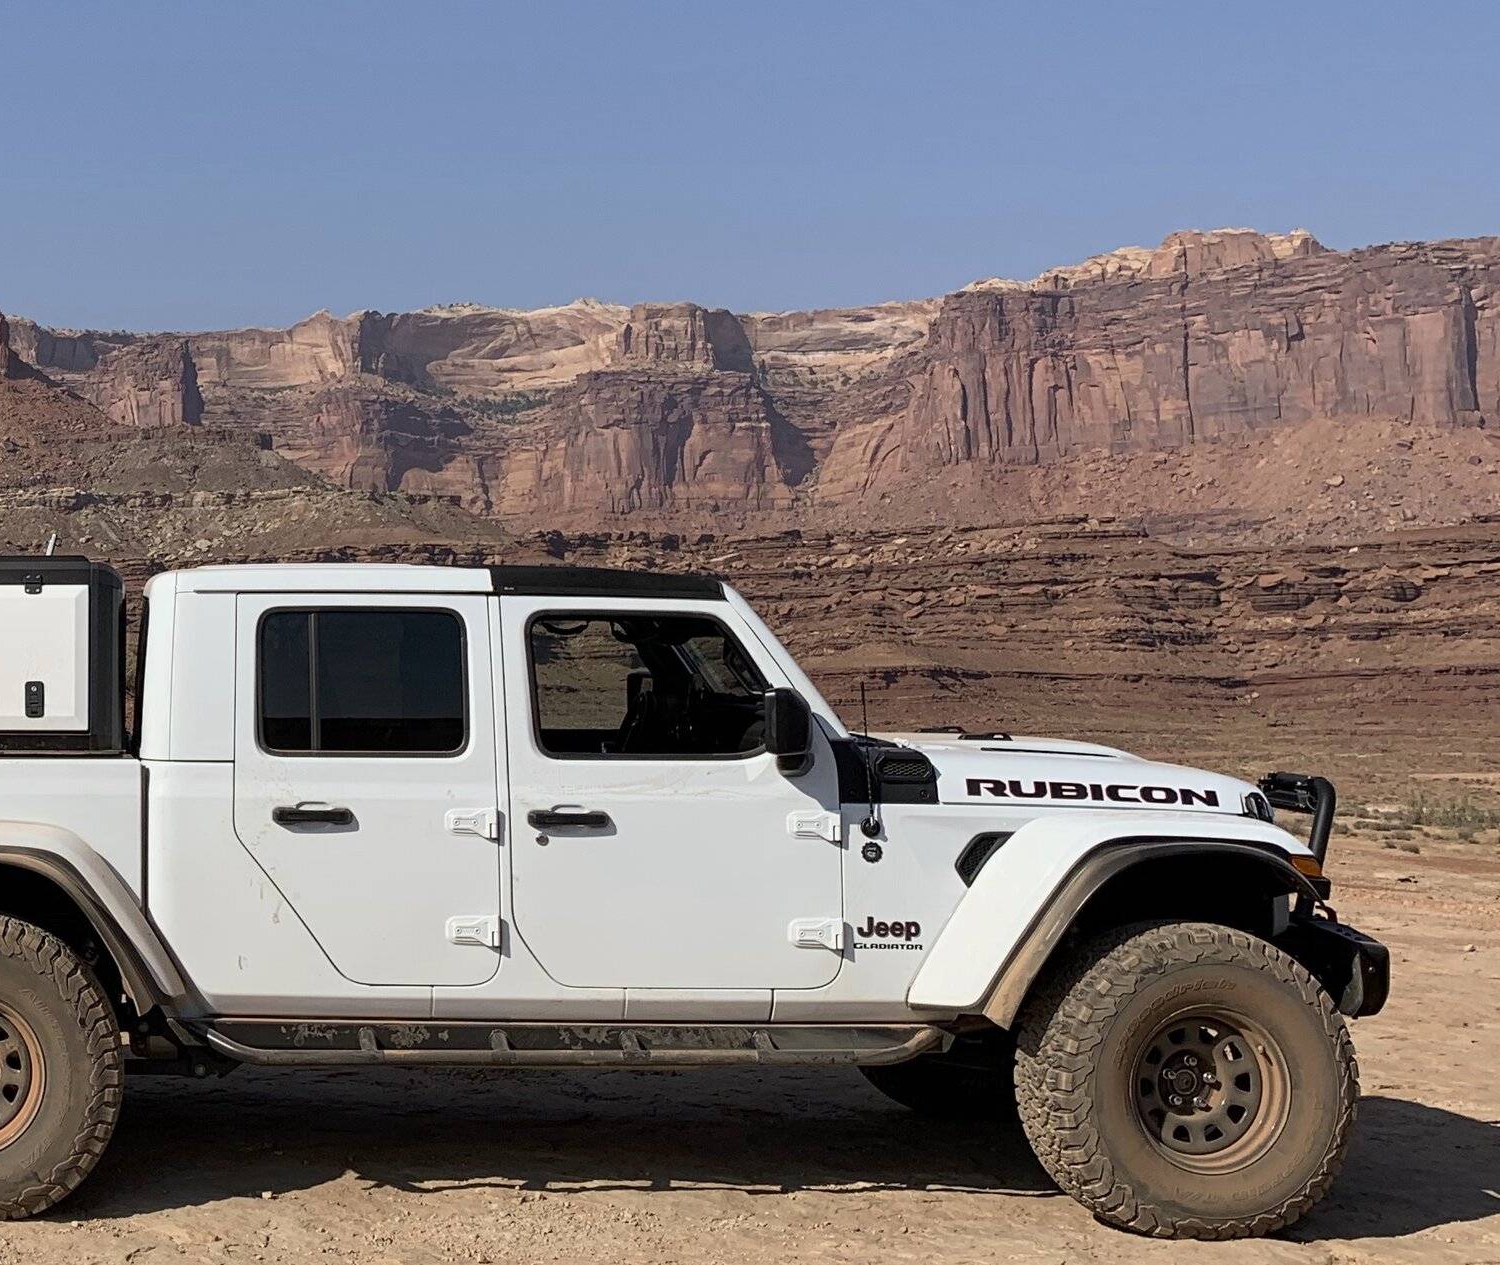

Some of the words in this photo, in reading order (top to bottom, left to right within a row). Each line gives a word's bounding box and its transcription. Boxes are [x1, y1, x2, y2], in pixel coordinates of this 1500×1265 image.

[965, 778, 1220, 807] RUBICON
[857, 916, 921, 941] Jeep
[853, 942, 924, 951] GLADIATOR
